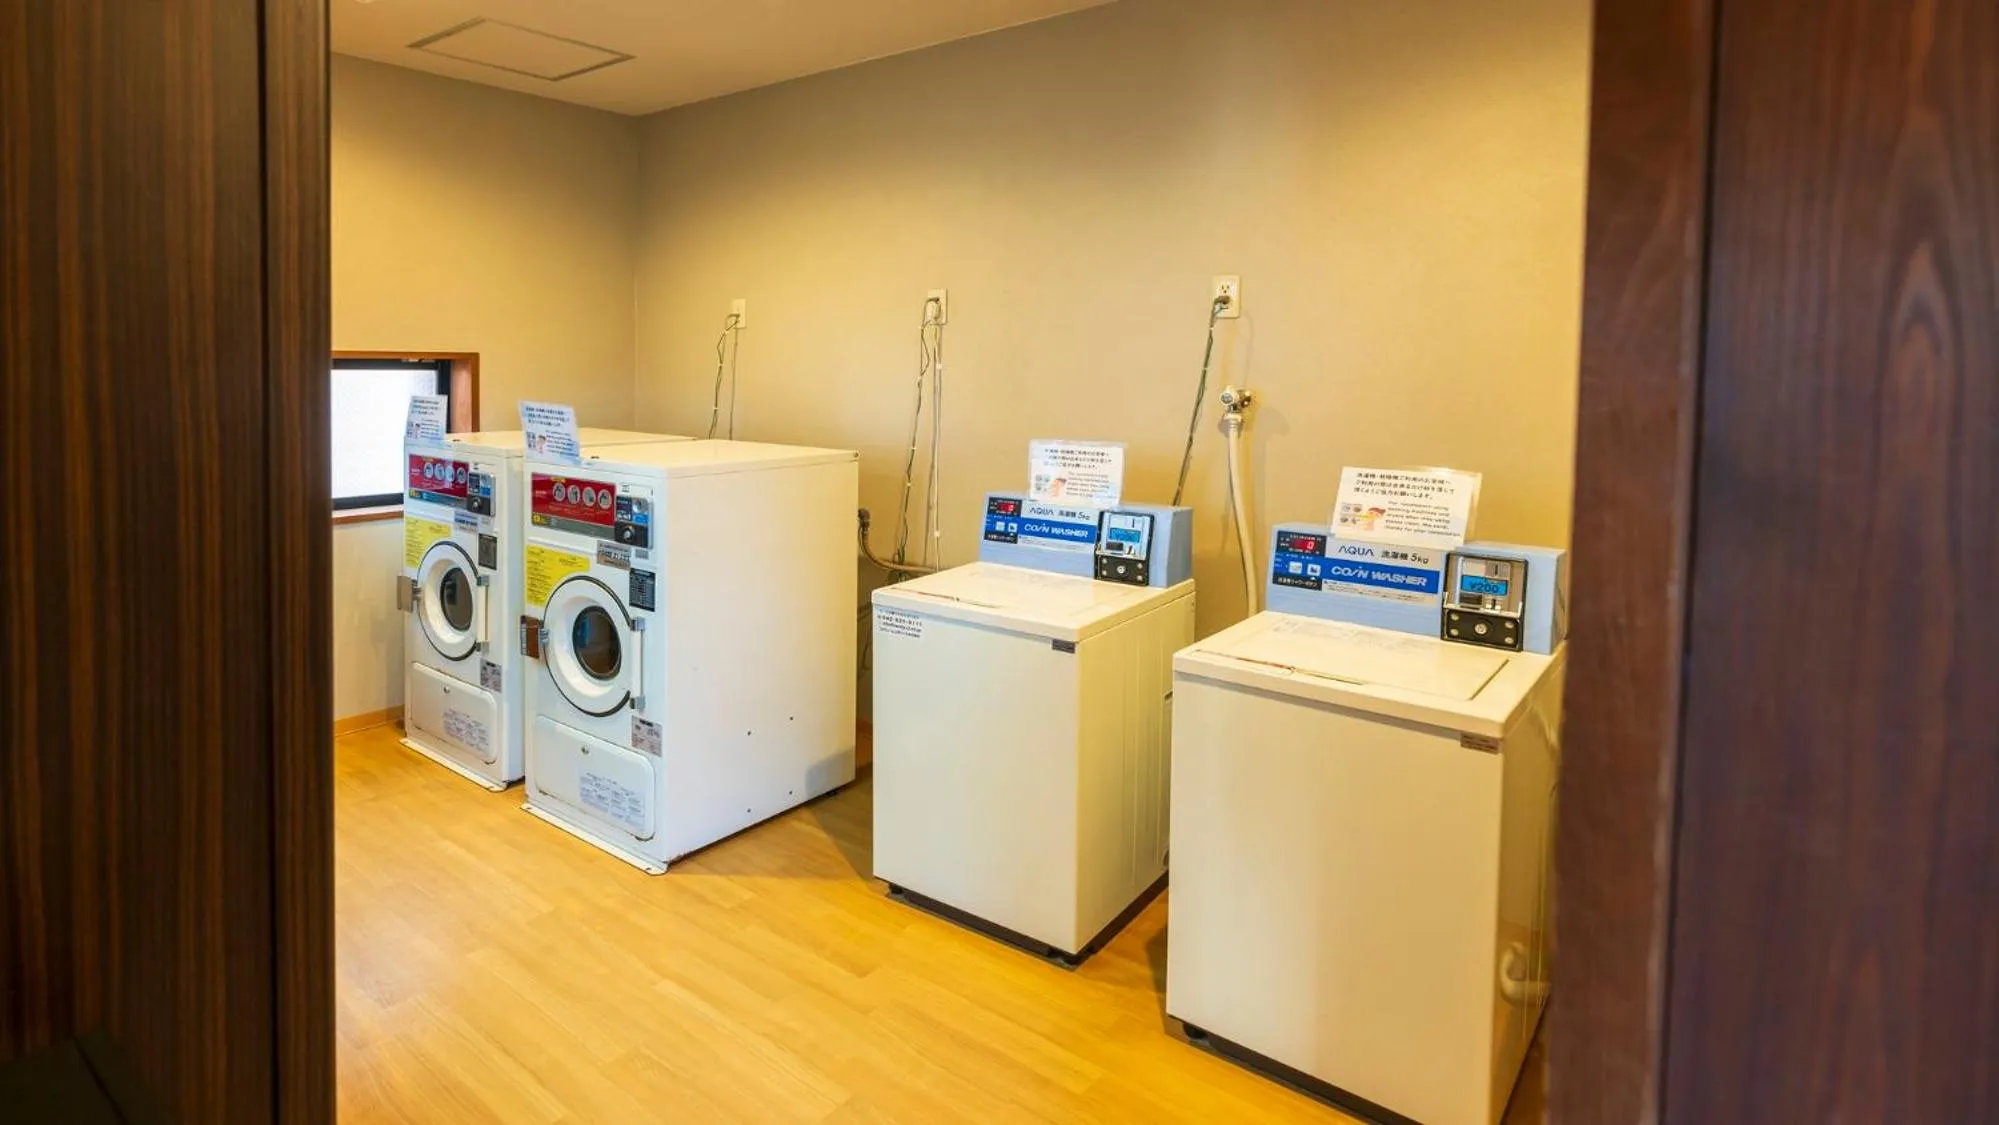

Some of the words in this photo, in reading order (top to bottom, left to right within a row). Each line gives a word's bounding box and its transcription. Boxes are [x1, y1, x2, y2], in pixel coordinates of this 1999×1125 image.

[1030, 507, 1054, 517] AQUA
[1051, 526, 1089, 538] WASHER
[1338, 545, 1375, 557] AQUA
[1381, 550, 1409, 561] 洗濯機
[1410, 551, 1430, 565] 5kg
[1371, 570, 1429, 587] WASHER
